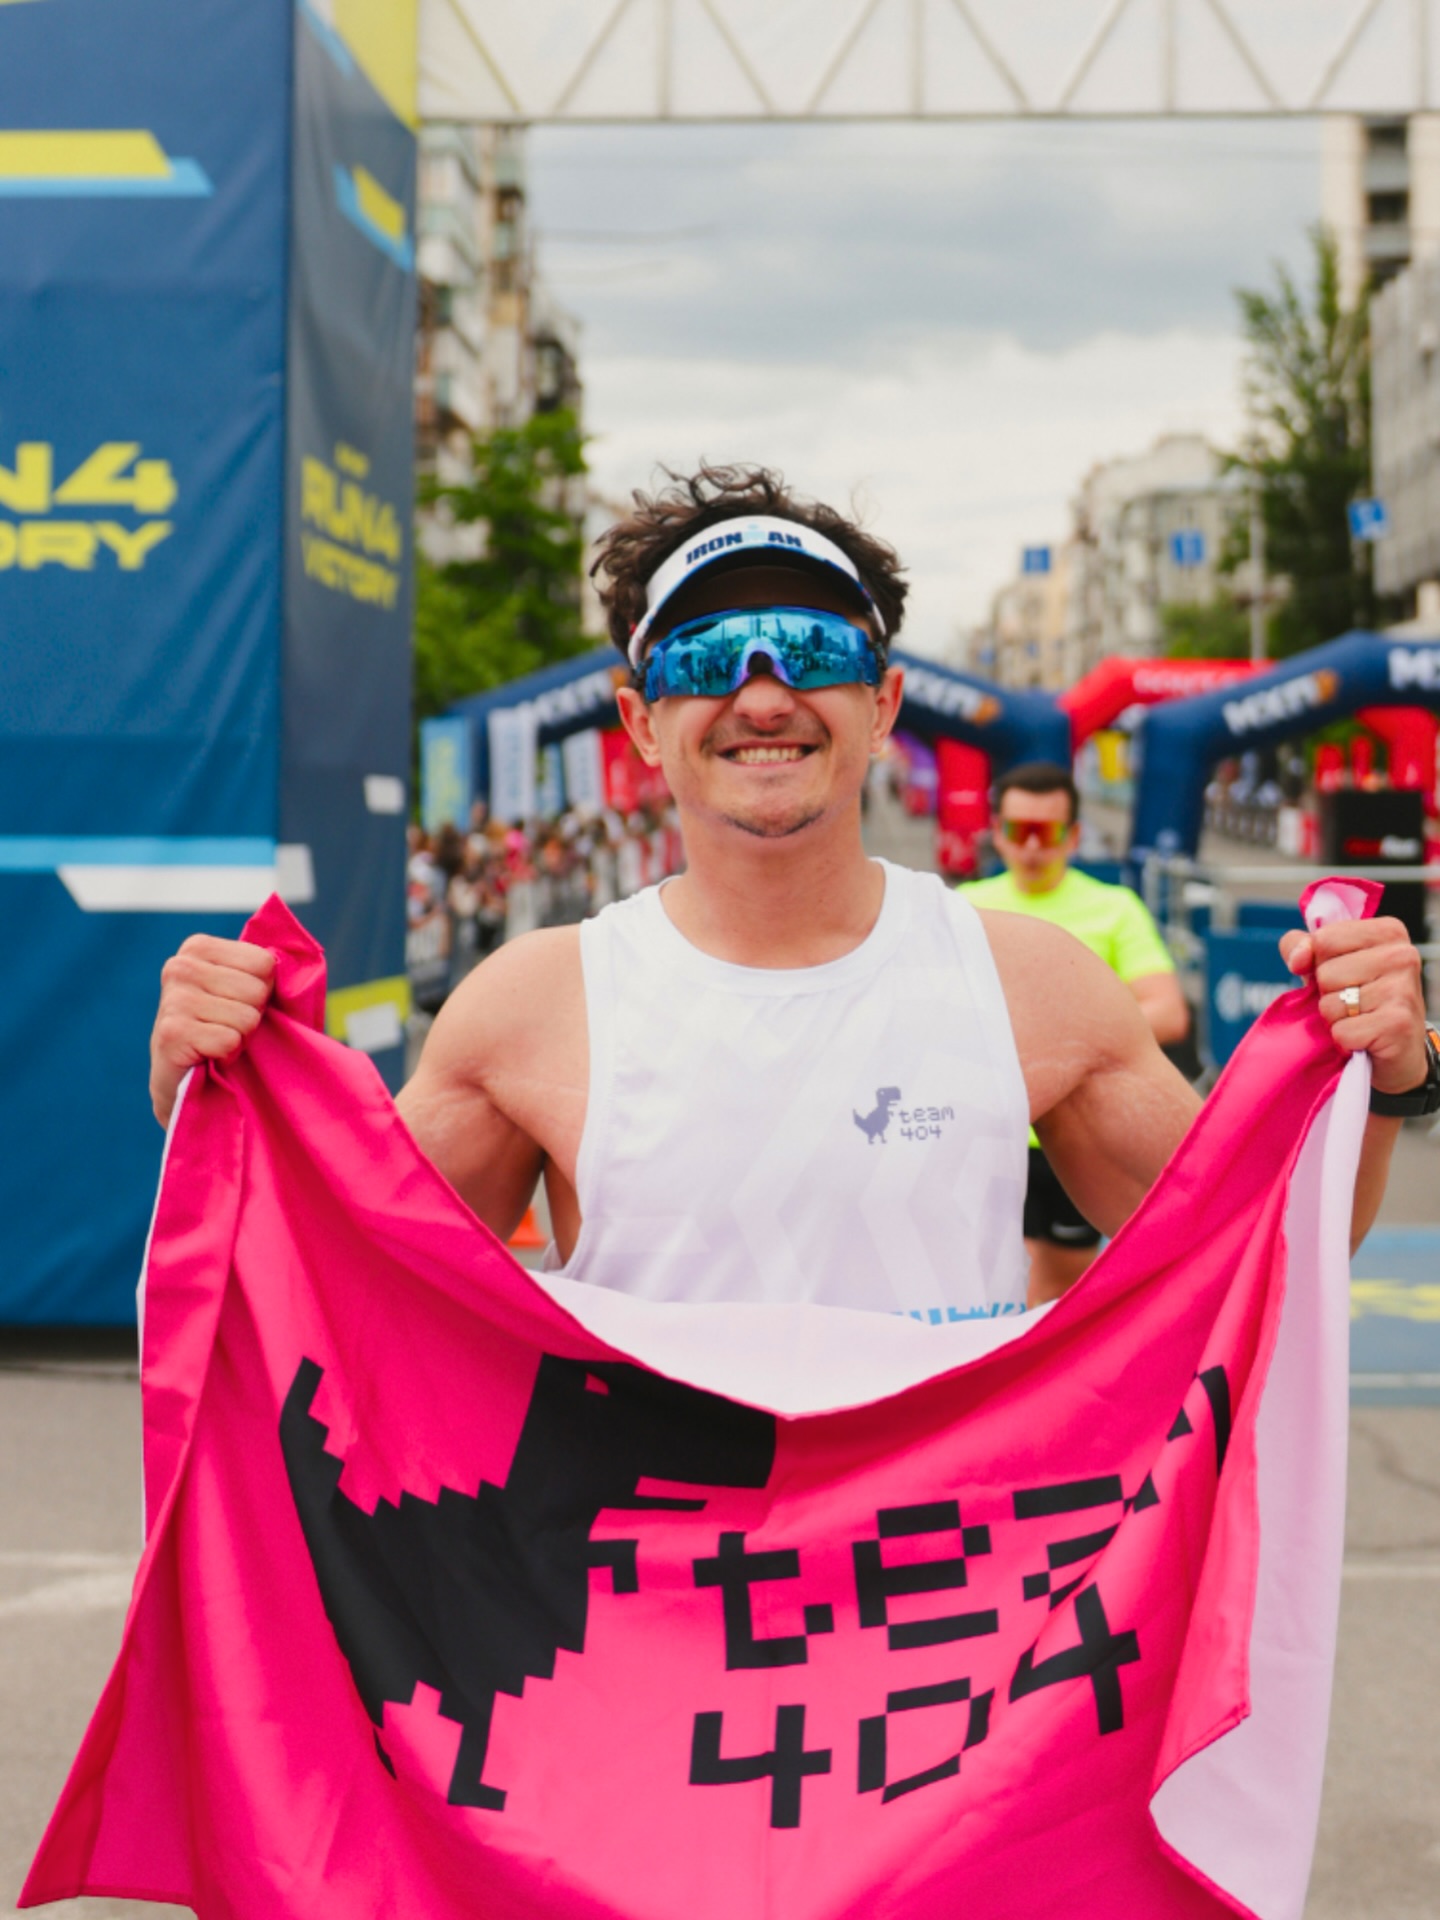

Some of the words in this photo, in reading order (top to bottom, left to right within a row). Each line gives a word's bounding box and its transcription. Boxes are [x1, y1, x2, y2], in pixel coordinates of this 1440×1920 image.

[0, 519, 174, 571] RY
[898, 1105, 955, 1124] team
[900, 1124, 942, 1141] 404
[688, 1582, 1141, 1829] 404
